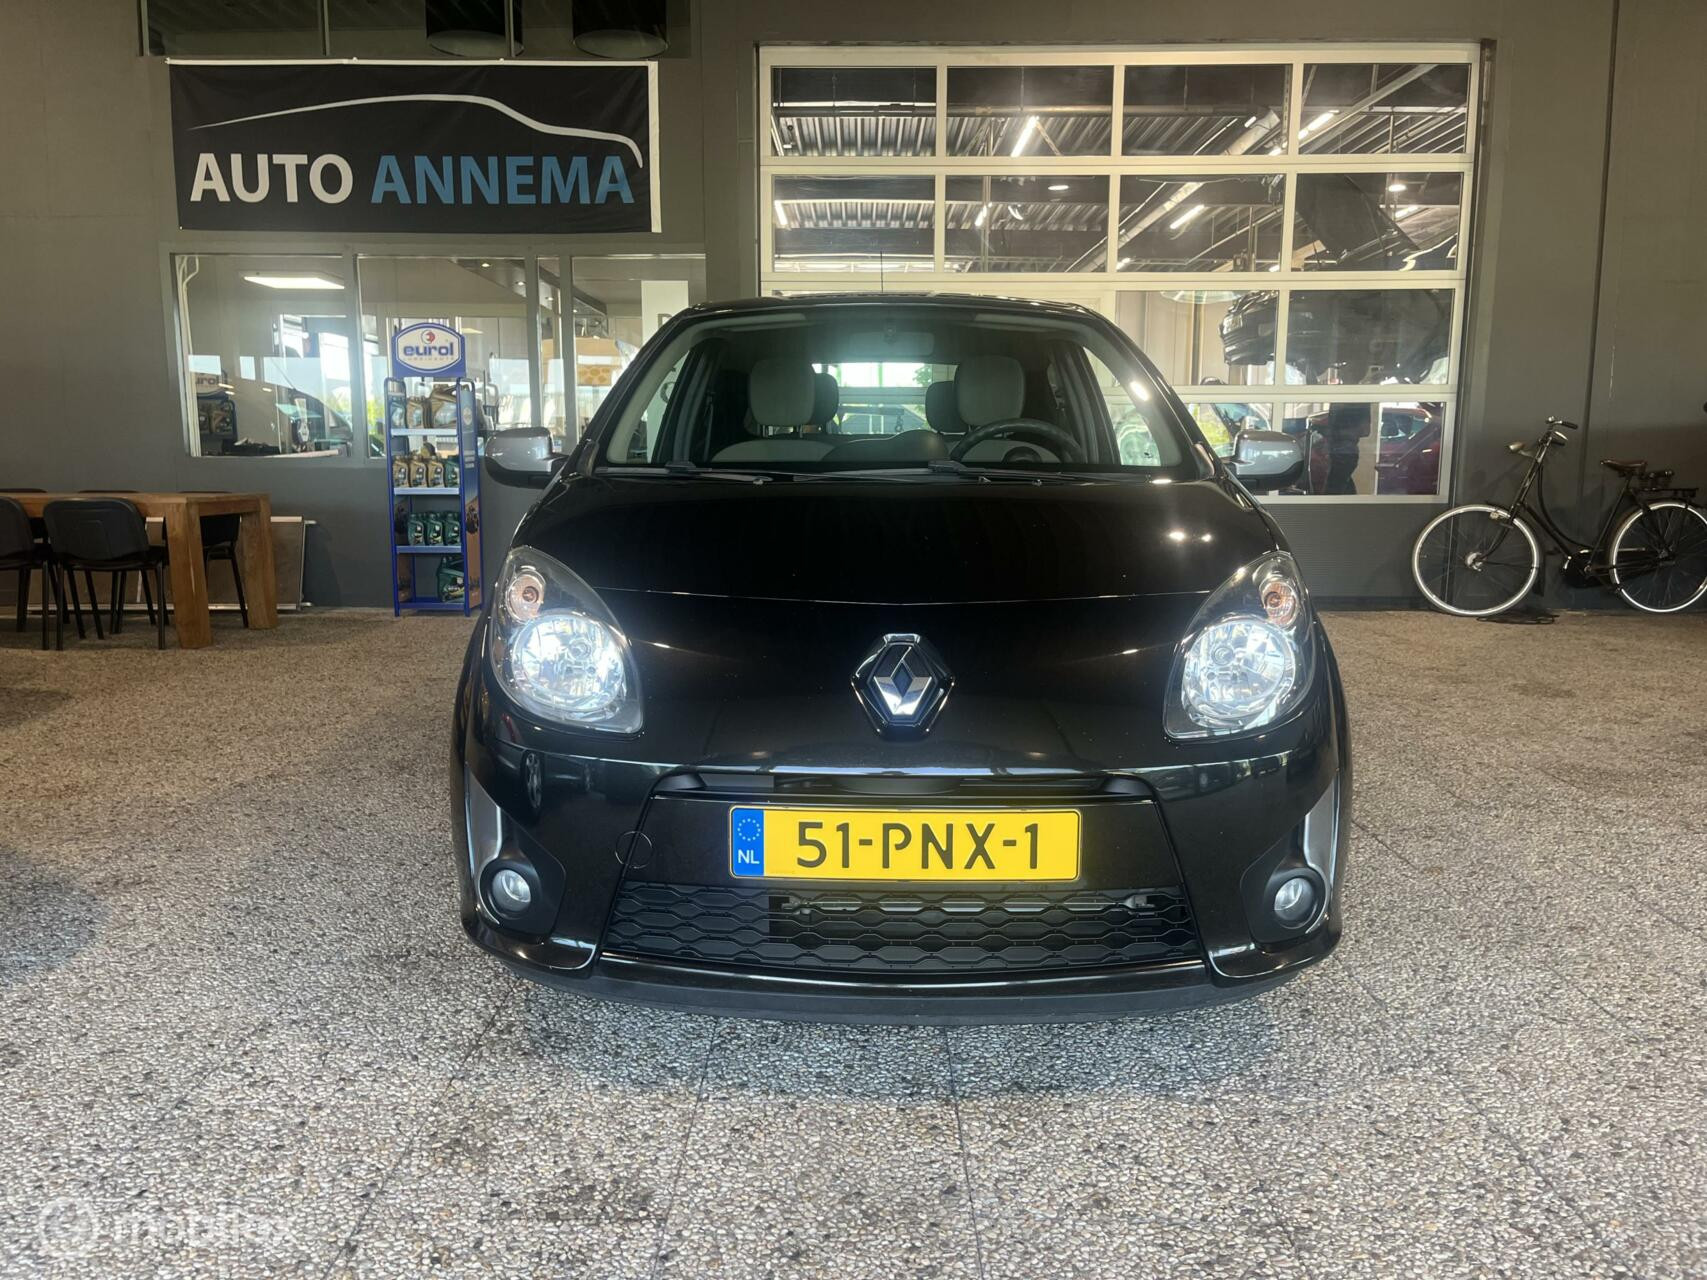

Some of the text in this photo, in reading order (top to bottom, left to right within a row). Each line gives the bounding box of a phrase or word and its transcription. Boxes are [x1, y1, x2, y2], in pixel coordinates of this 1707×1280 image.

[190, 153, 635, 205] AUTO ANNEMA
[403, 342, 454, 356] eurol
[738, 849, 760, 865] NL
[796, 821, 1039, 869] 51-PNX-1
